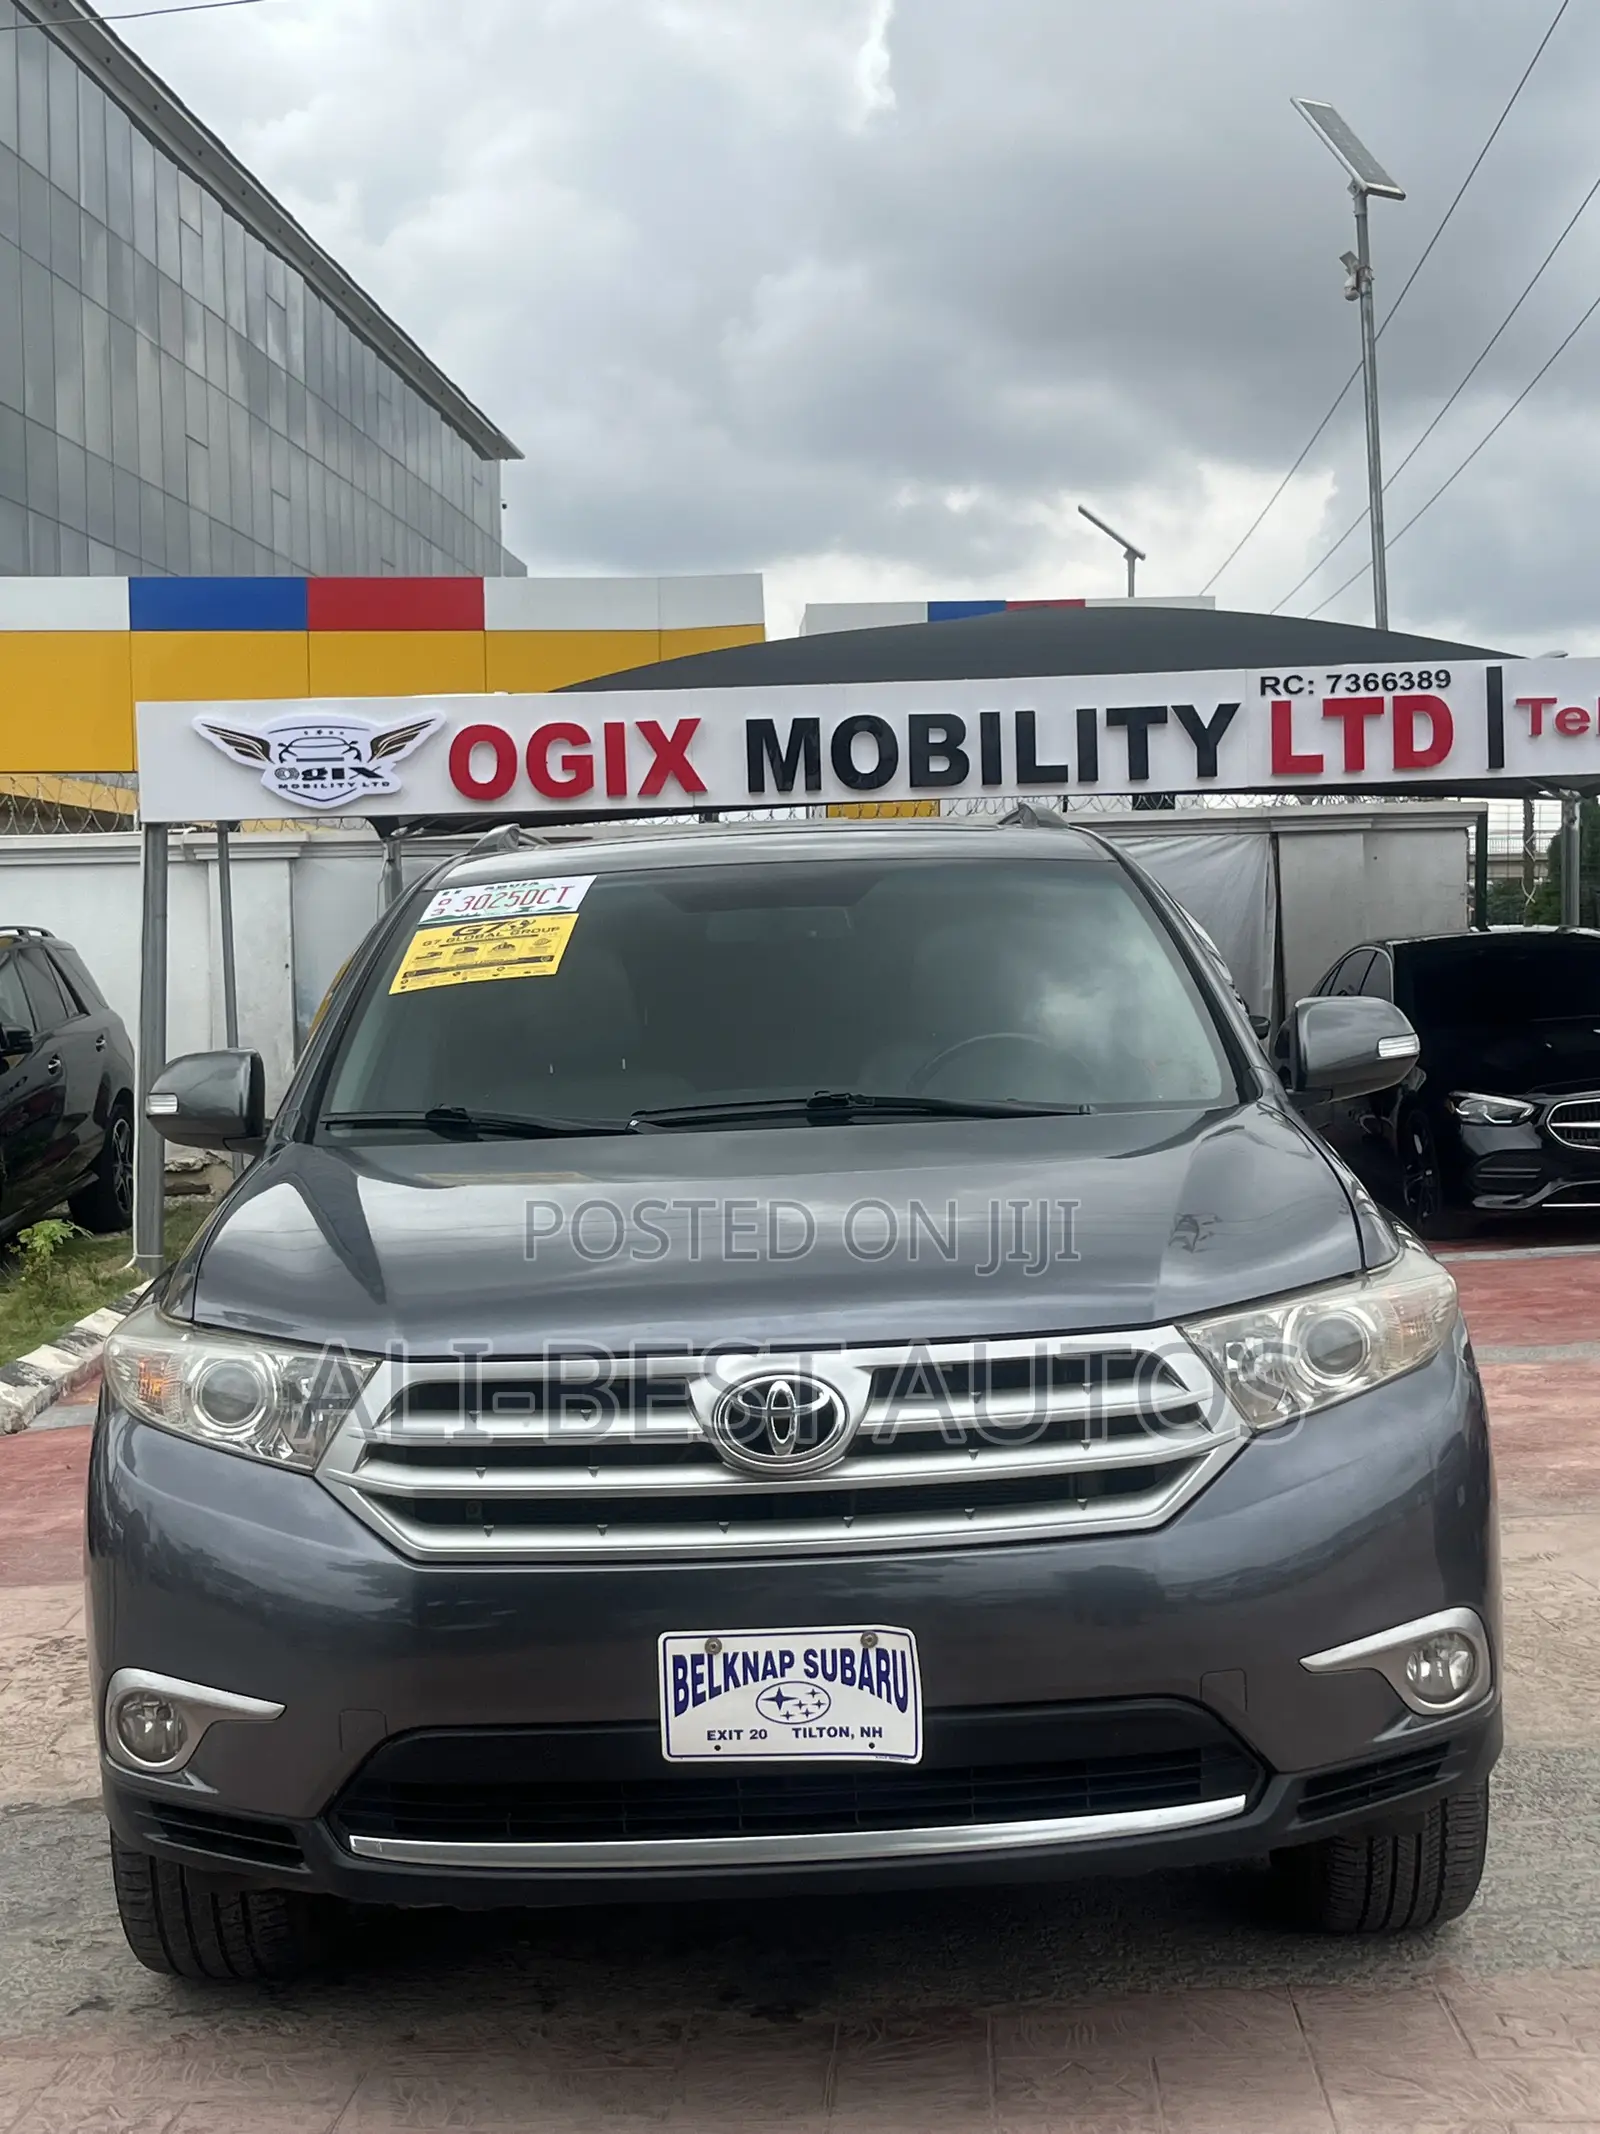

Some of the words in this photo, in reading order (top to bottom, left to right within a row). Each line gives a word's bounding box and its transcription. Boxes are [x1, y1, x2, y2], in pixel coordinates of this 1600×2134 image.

[1259, 674, 1315, 697] RC:
[1326, 669, 1452, 694] 7366389
[1515, 697, 1600, 736] Te
[449, 718, 708, 800] OGIX
[746, 702, 1241, 794] MOBILITY
[1270, 694, 1454, 775] LTD
[422, 939, 442, 947] G7
[446, 932, 505, 943] GLOBAL
[510, 926, 560, 936] GROUP
[671, 1649, 796, 1718] BELKNAP
[802, 1647, 909, 1715] SUBARU
[706, 1729, 744, 1741] EXIT
[749, 1728, 768, 1740] 20
[791, 1726, 855, 1740] TILTON,
[860, 1726, 883, 1738] NH
